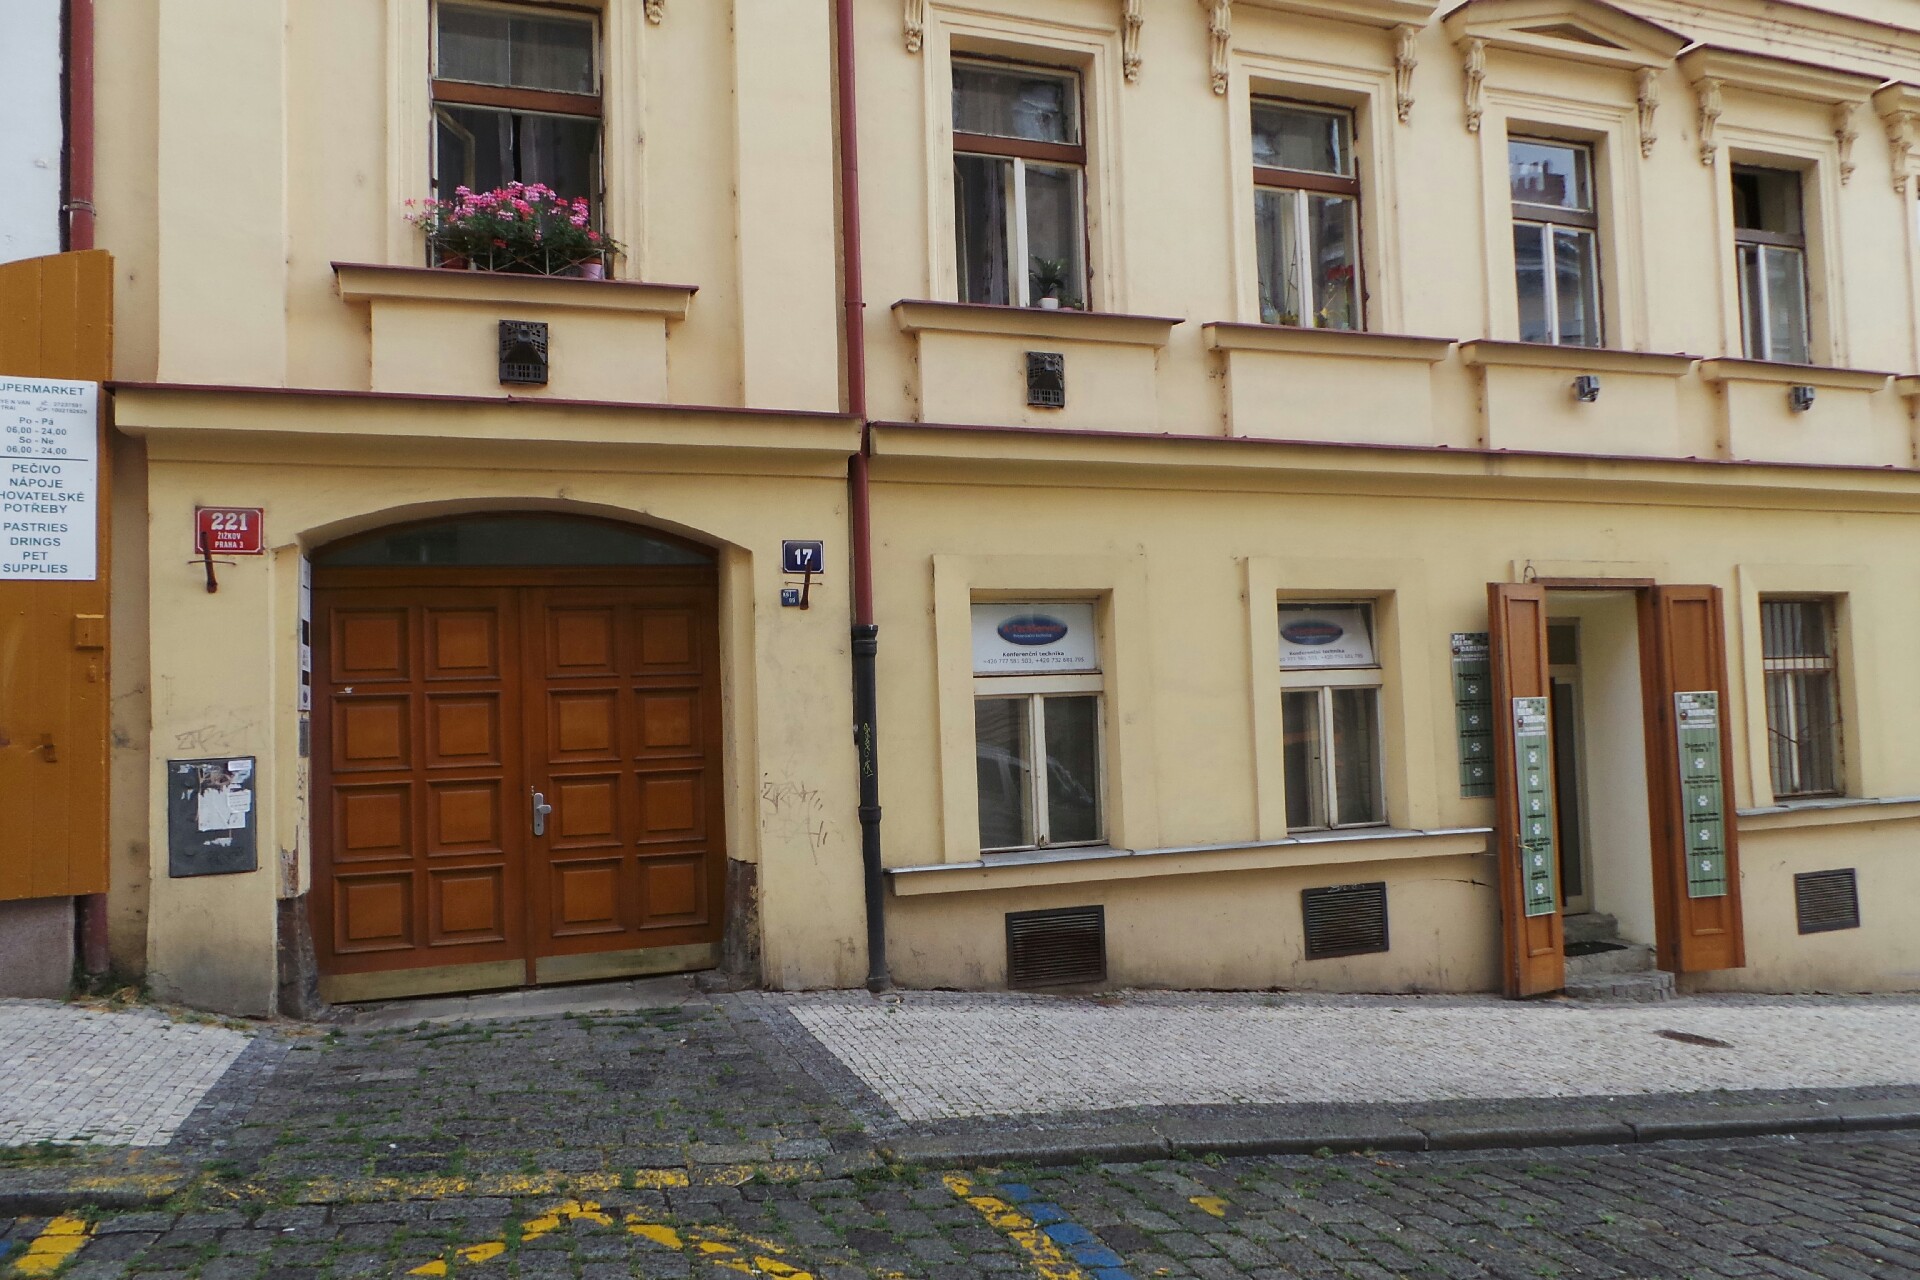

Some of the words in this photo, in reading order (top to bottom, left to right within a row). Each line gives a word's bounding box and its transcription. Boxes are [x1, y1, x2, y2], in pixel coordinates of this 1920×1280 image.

[19, 416, 32, 424] Po
[19, 436, 32, 444] So
[41, 437, 54, 445] Ne
[12, 463, 61, 474] PEČIVO
[9, 476, 63, 488] NÁPOJE
[4, 502, 68, 513] POTŘEBY
[211, 512, 248, 531] 221
[3, 522, 68, 532] PASTRIES
[217, 531, 241, 540] ŽIŽKOV
[10, 537, 61, 547] DRINGS
[239, 541, 244, 549] 3
[23, 551, 48, 560] PET
[794, 548, 813, 565] 17
[3, 563, 68, 573] SUPPLIES
